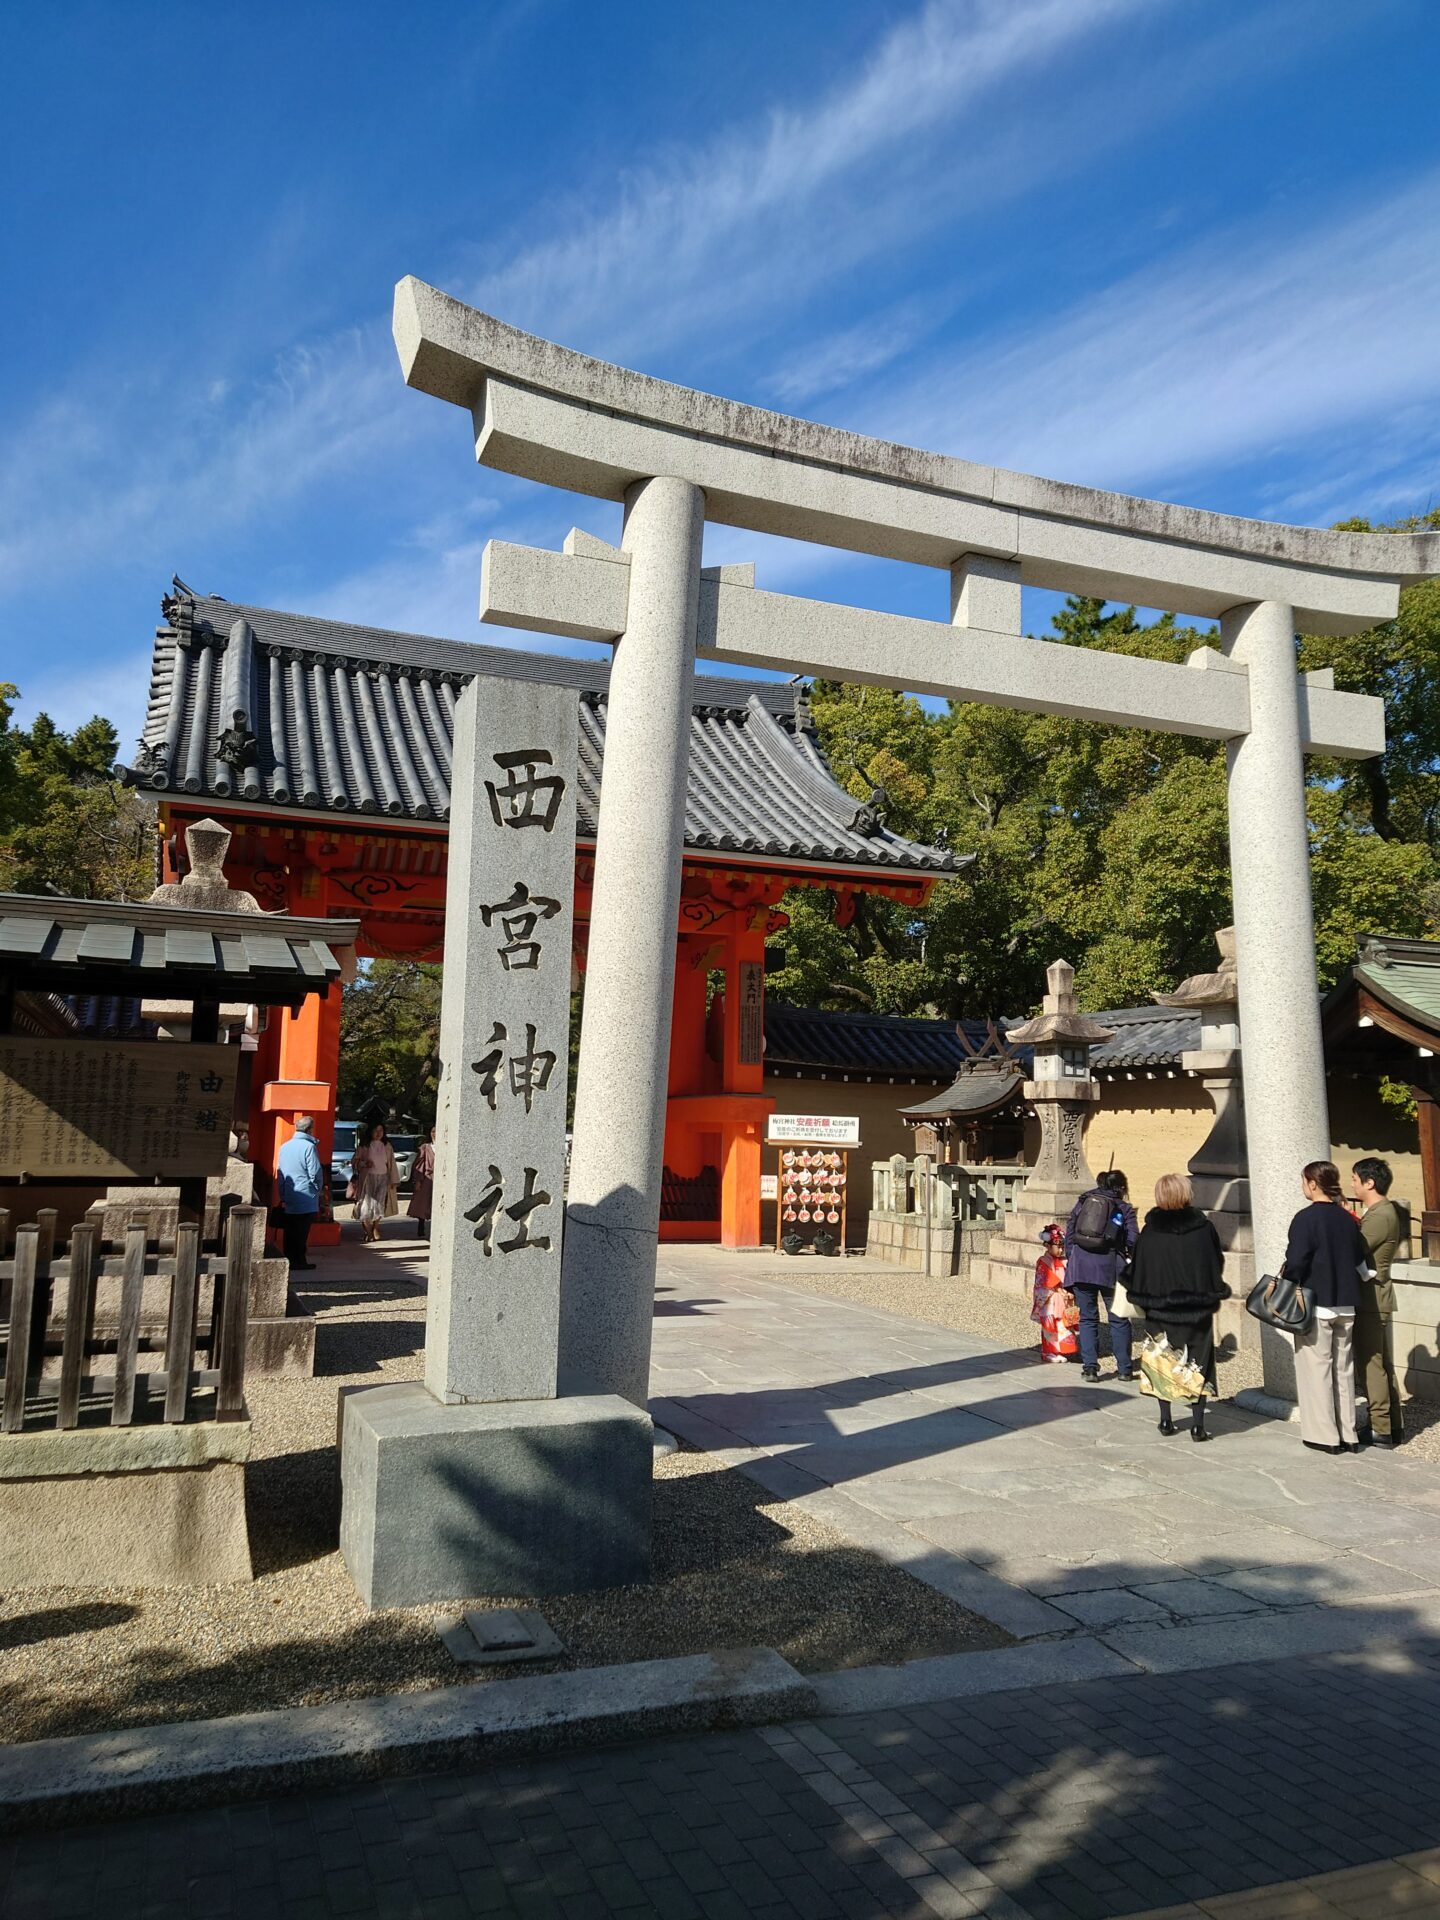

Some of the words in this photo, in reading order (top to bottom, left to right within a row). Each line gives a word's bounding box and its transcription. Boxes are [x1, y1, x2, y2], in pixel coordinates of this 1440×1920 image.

[464, 748, 567, 1257] 西宮神社
[194, 1070, 224, 1132] 由緒
[796, 1117, 831, 1127] 安産祈願
